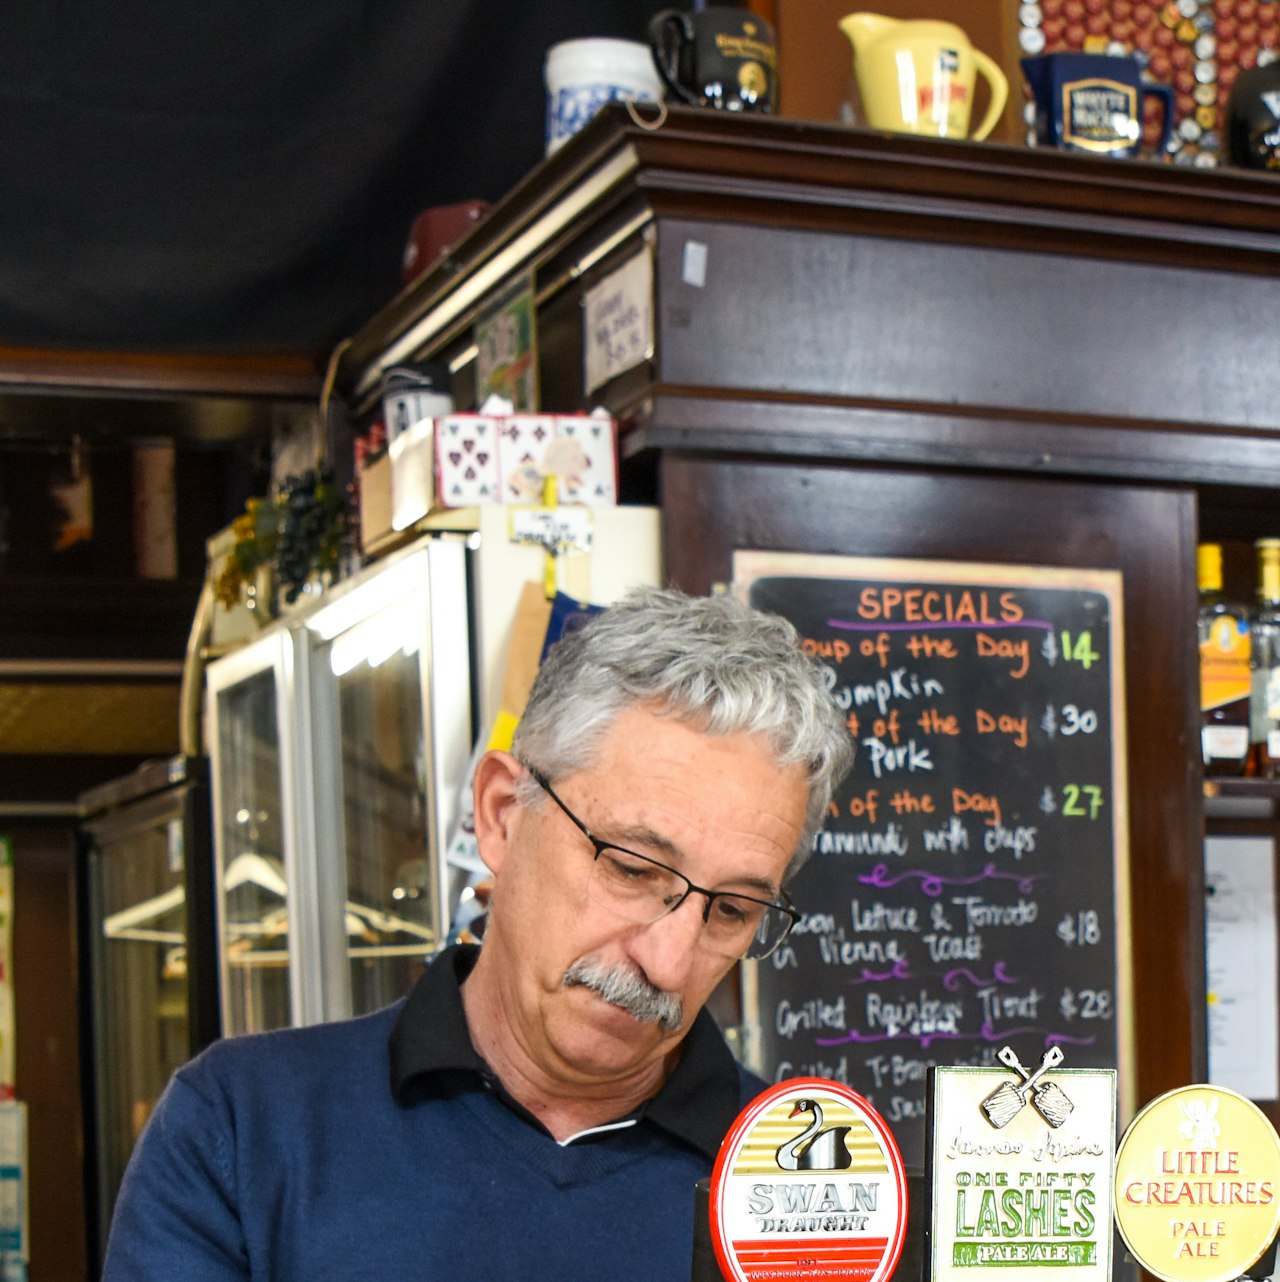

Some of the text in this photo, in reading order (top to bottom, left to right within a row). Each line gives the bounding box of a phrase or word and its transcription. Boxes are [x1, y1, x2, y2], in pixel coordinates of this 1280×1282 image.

[857, 588, 1025, 624] SPECIALS
[800, 630, 1100, 679] oup of the Day $14
[873, 710, 901, 743] of
[917, 708, 961, 737] the
[976, 709, 1029, 748] Day
[1039, 704, 1099, 739] $30
[863, 737, 934, 778] Pork
[849, 789, 879, 823] of
[890, 787, 936, 814] the
[952, 787, 1001, 827] Day
[1039, 783, 1104, 821] $27
[813, 816, 1038, 860] ramundi with chips
[791, 897, 1101, 947] acon, Lettuce & Tomato $18
[821, 936, 906, 966] Vienna
[776, 995, 846, 1039] Grilled
[1060, 989, 1112, 1020] $28
[776, 1056, 849, 1084] Gilled
[1162, 1151, 1240, 1175] LITTLE
[955, 1171, 1096, 1187] ONE FIFTY
[1125, 1181, 1274, 1207] CREATURES
[747, 1183, 880, 1214] SWAN
[955, 1189, 1096, 1237] LASHES
[758, 1215, 869, 1234] DRAUGHT
[1173, 1221, 1226, 1238] PALE
[981, 1244, 1070, 1262] PALE ALE
[1180, 1241, 1220, 1258] ALE
